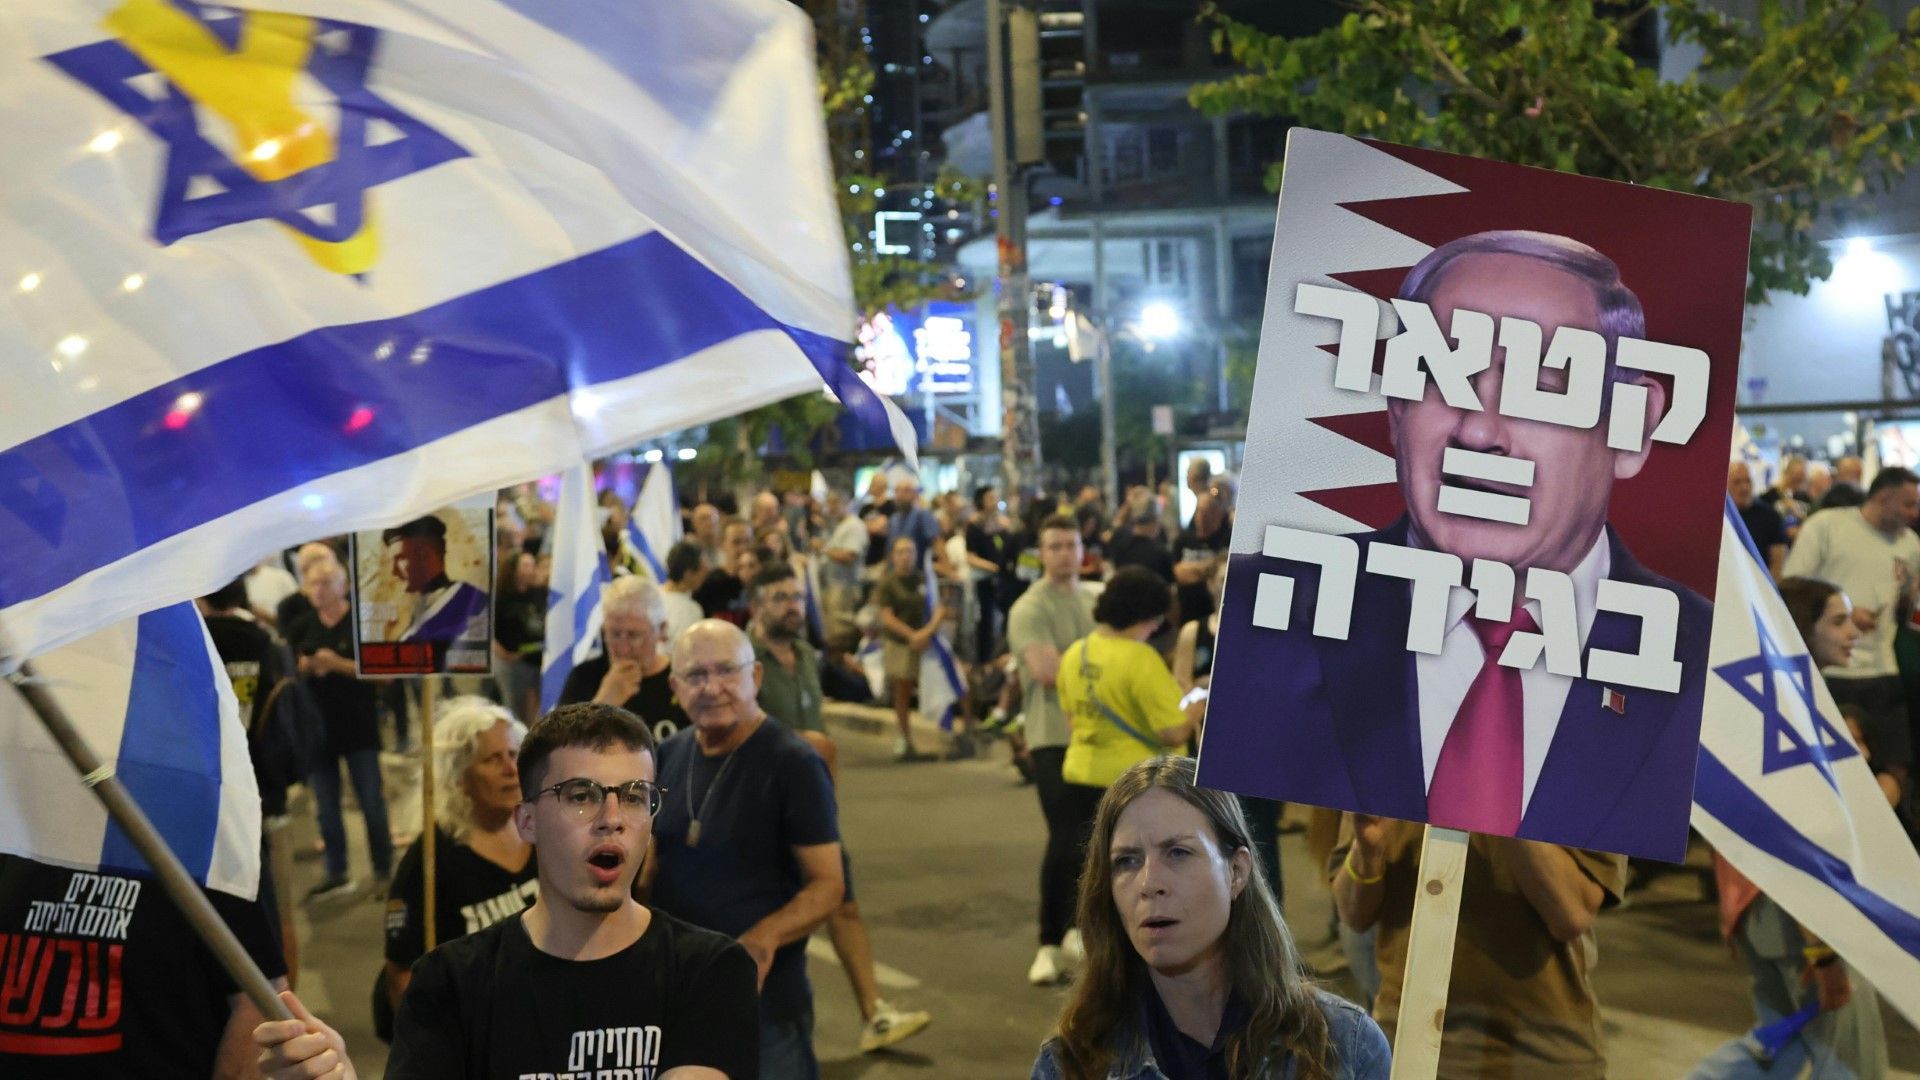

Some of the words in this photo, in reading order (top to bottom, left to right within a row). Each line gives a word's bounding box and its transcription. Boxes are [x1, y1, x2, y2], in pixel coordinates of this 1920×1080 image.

[1294, 282, 1711, 452] קטאר
[1252, 523, 1684, 694] בגידה
[64, 872, 142, 911] מחזירים
[24, 900, 81, 935] הביתה
[77, 904, 134, 940] אותם
[567, 1025, 662, 1072] מחזירים
